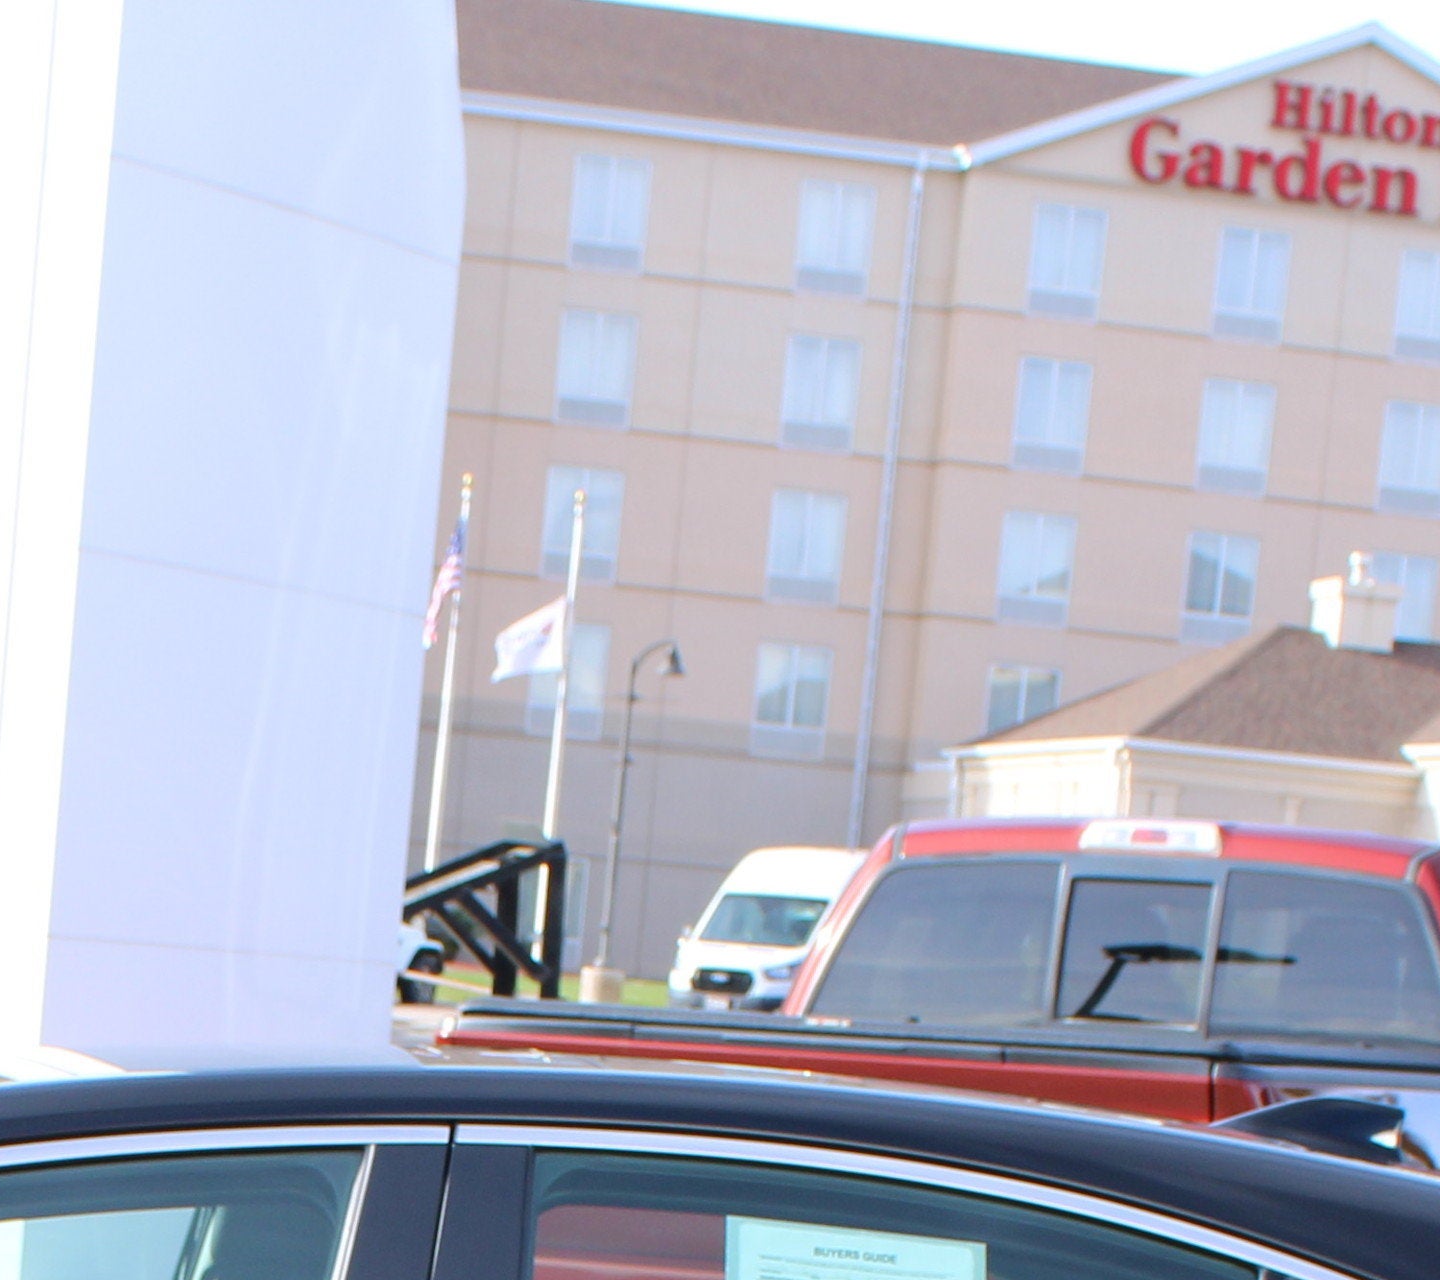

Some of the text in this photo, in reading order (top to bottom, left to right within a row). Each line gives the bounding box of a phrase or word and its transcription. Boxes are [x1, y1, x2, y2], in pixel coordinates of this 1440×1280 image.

[1128, 115, 1418, 217] Garden
[812, 1246, 898, 1264] BUYERS GUIDE
